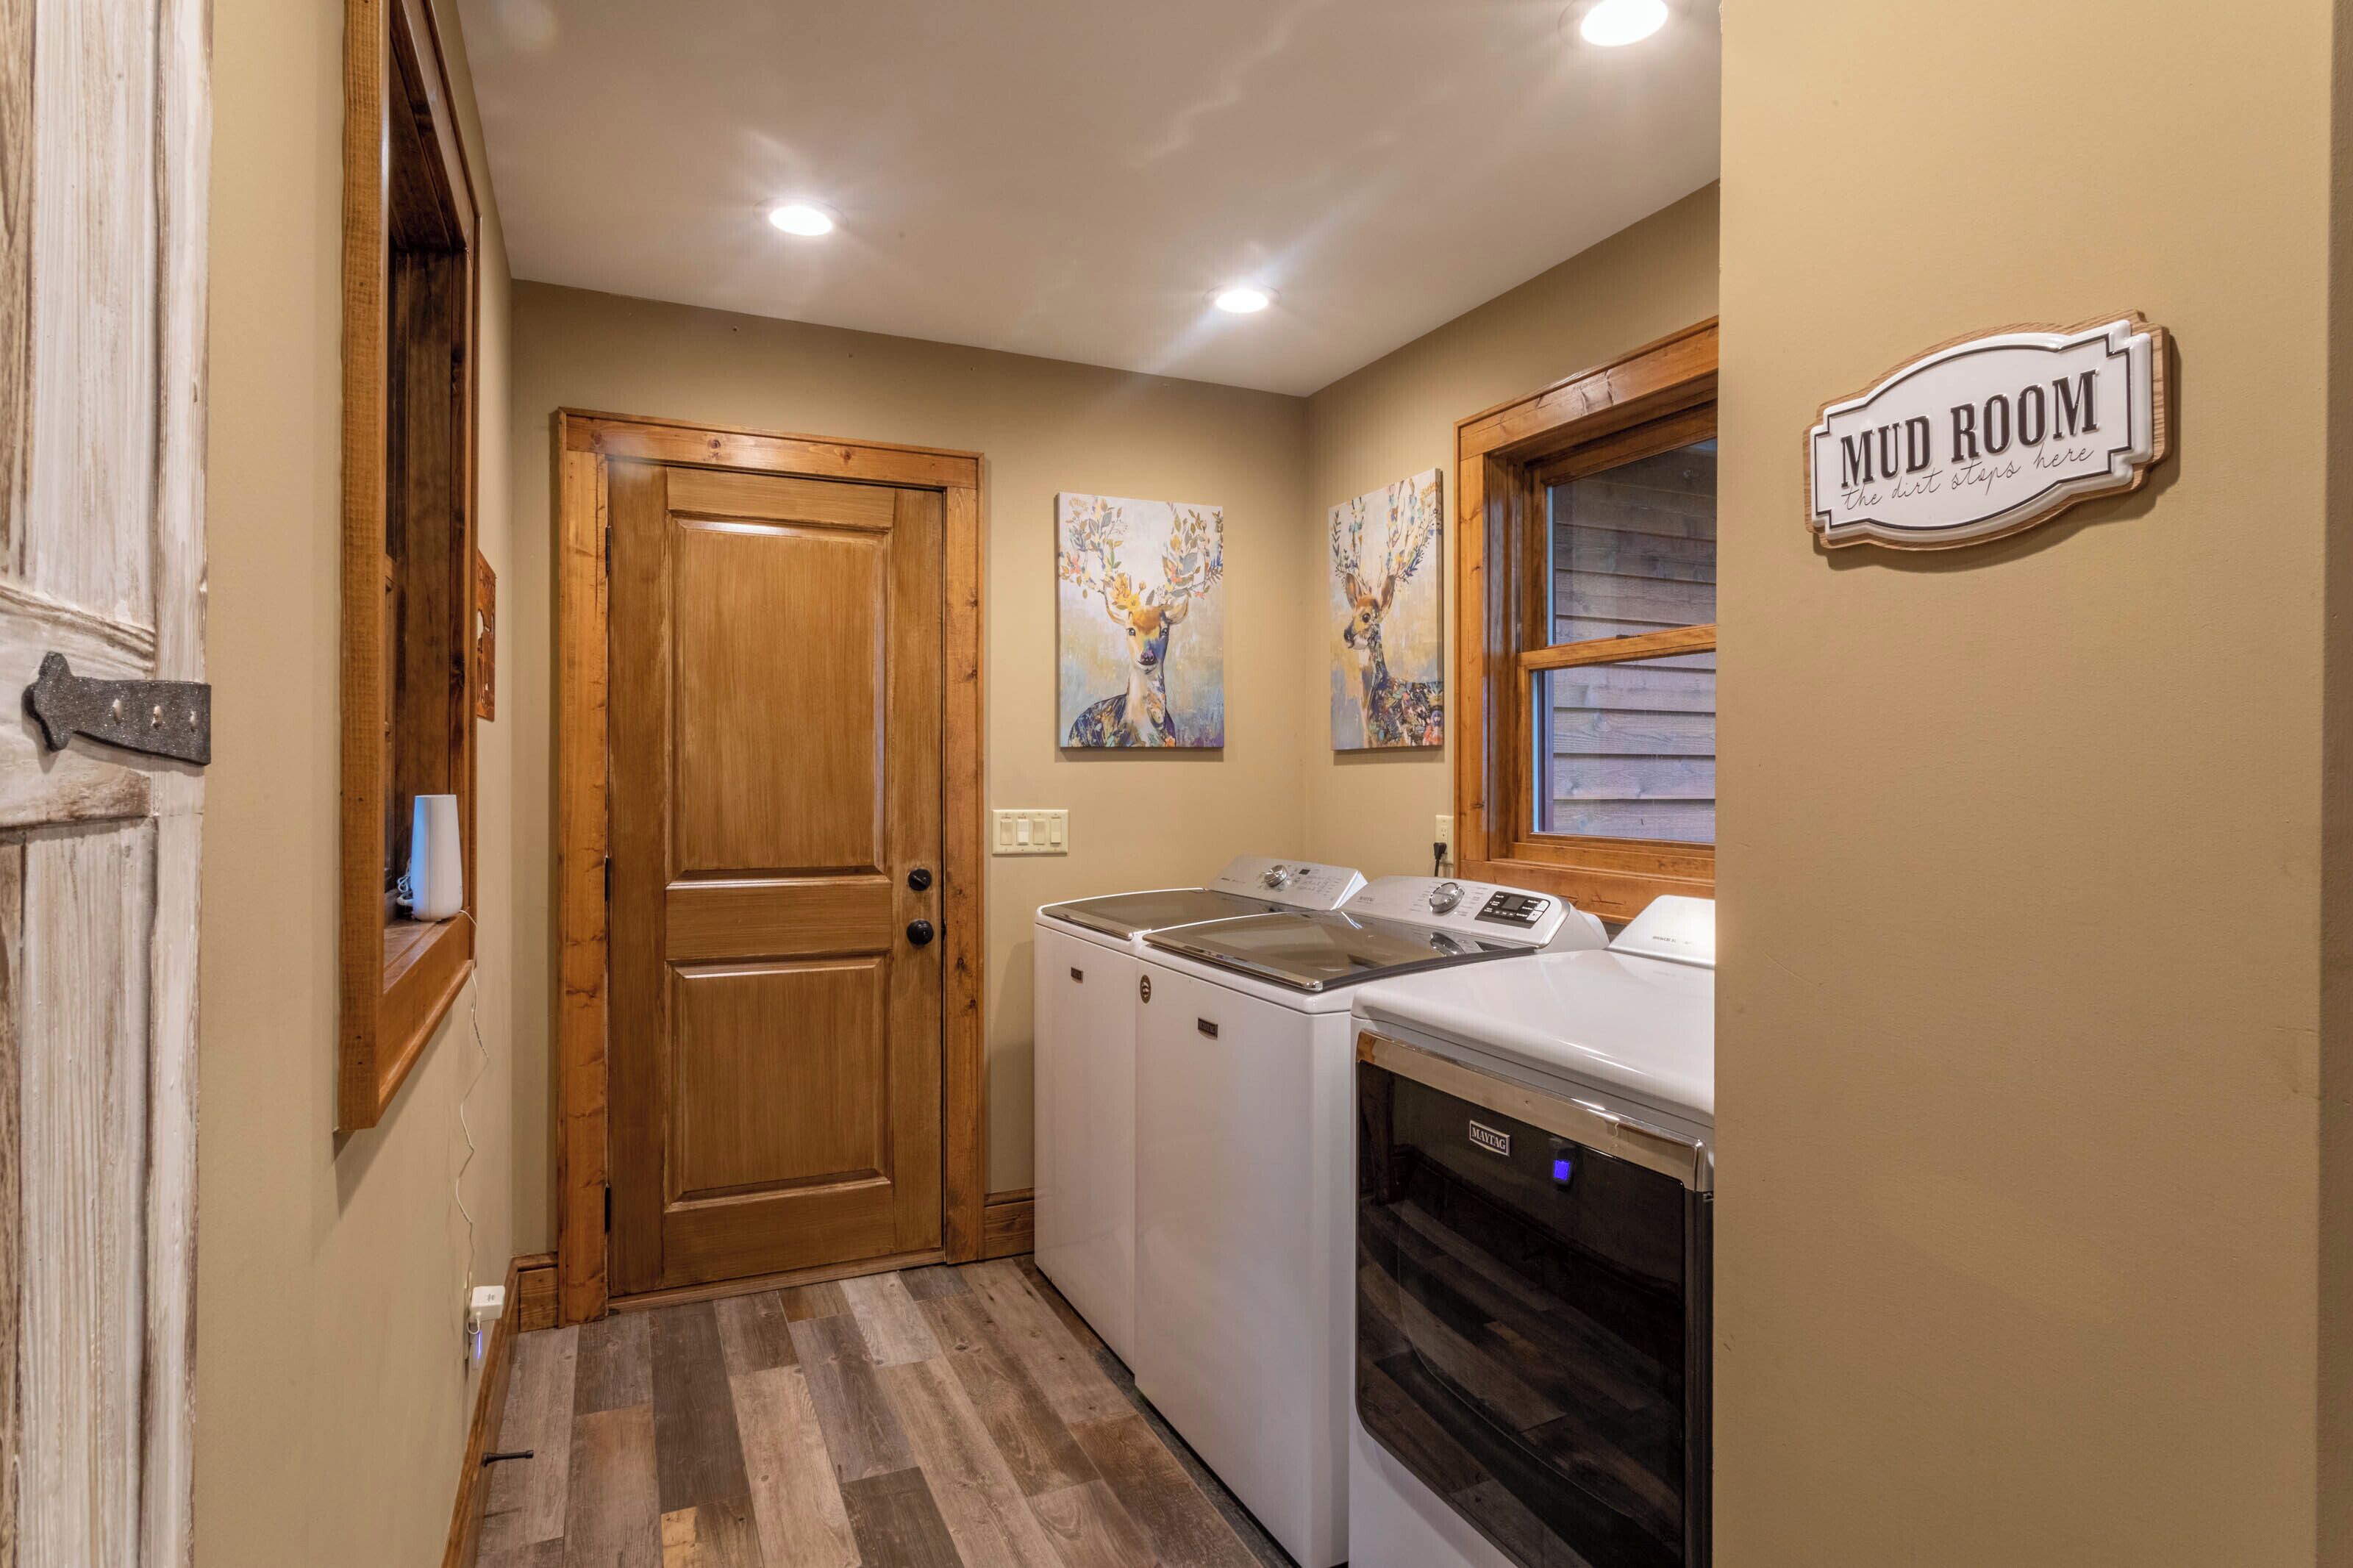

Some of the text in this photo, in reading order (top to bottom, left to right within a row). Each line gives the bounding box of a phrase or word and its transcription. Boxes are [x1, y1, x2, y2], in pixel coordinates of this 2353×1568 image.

[1840, 369, 2099, 488] MUD ROOM
[1840, 442, 2094, 510] the dirt stops here
[1471, 1127, 1506, 1150] MAYTAG
